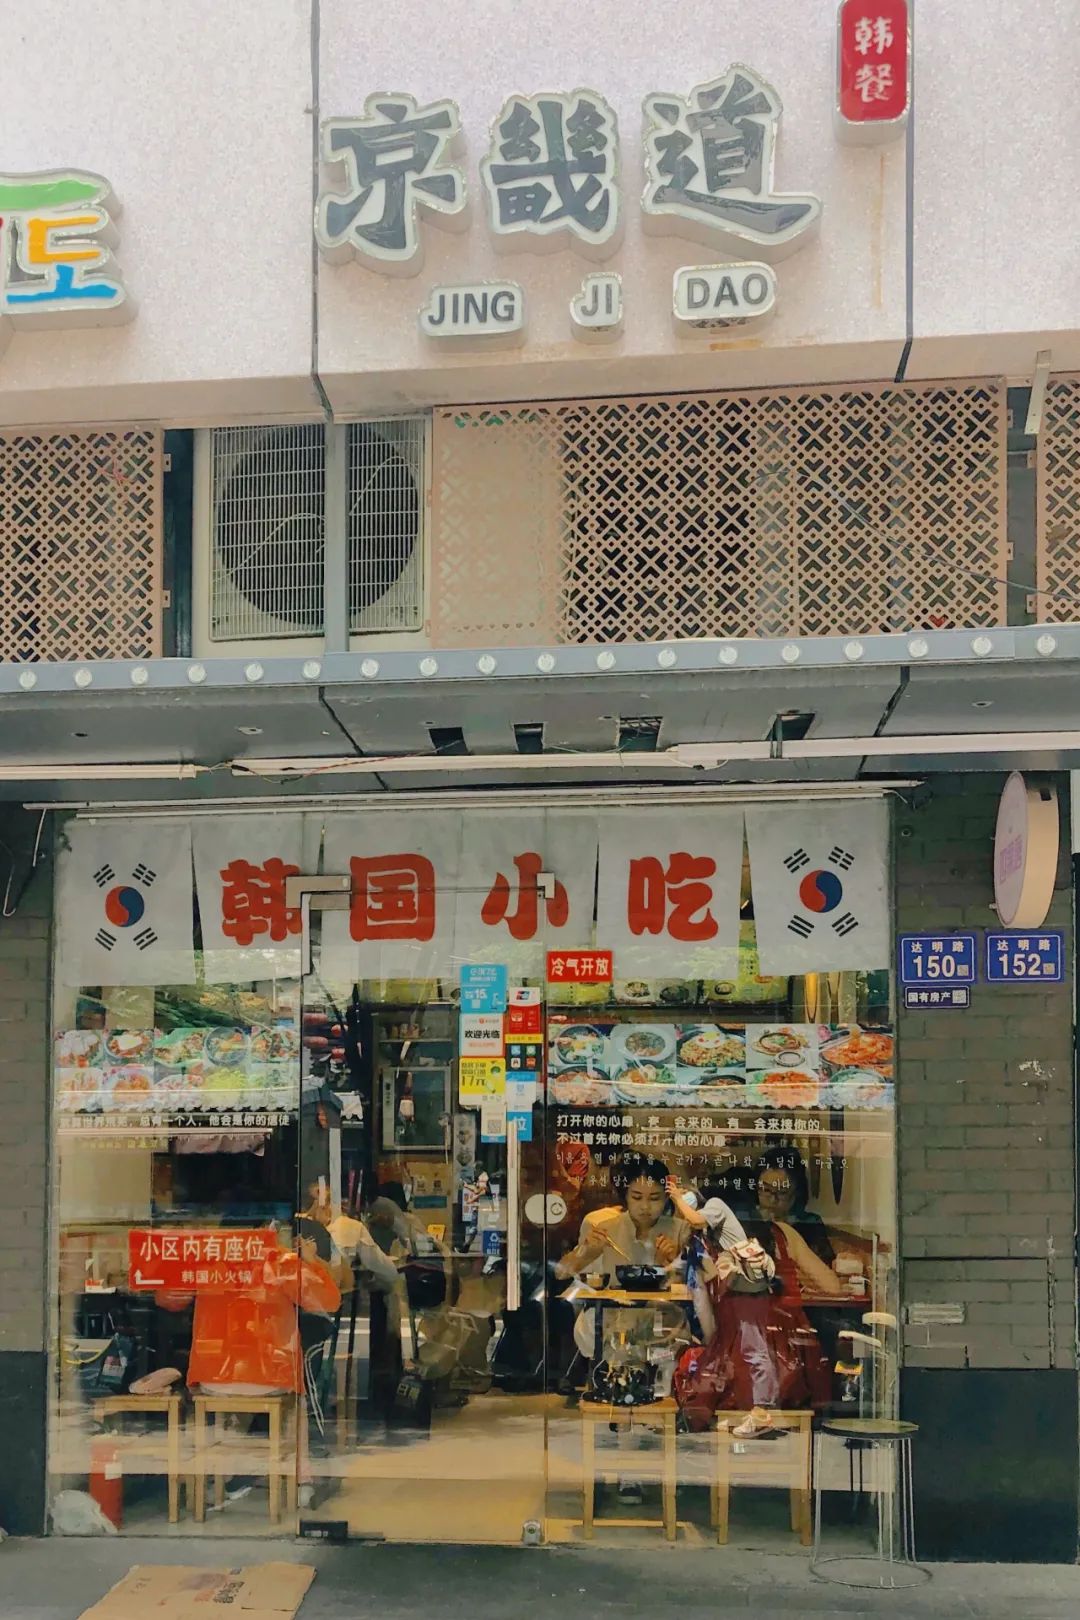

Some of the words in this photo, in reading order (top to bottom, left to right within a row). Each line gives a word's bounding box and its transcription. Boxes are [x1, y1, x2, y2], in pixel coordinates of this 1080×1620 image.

[853, 16, 894, 103] 韩餐
[326, 74, 812, 249] 京畿道
[428, 290, 516, 326] JING
[580, 283, 614, 317] JI
[686, 273, 769, 310] DAO
[219, 852, 719, 946] 韩国小吃
[910, 940, 965, 953] 达明路
[996, 938, 1051, 951] 达明路
[550, 956, 610, 978] 冷气开放
[912, 954, 956, 978] 150
[998, 952, 1042, 976] 152
[907, 991, 951, 1004] 国有房产
[464, 1029, 500, 1039] 欢迎光临
[140, 1235, 265, 1261] 小区内有座位
[181, 1270, 253, 1283] 韩国小火锅
